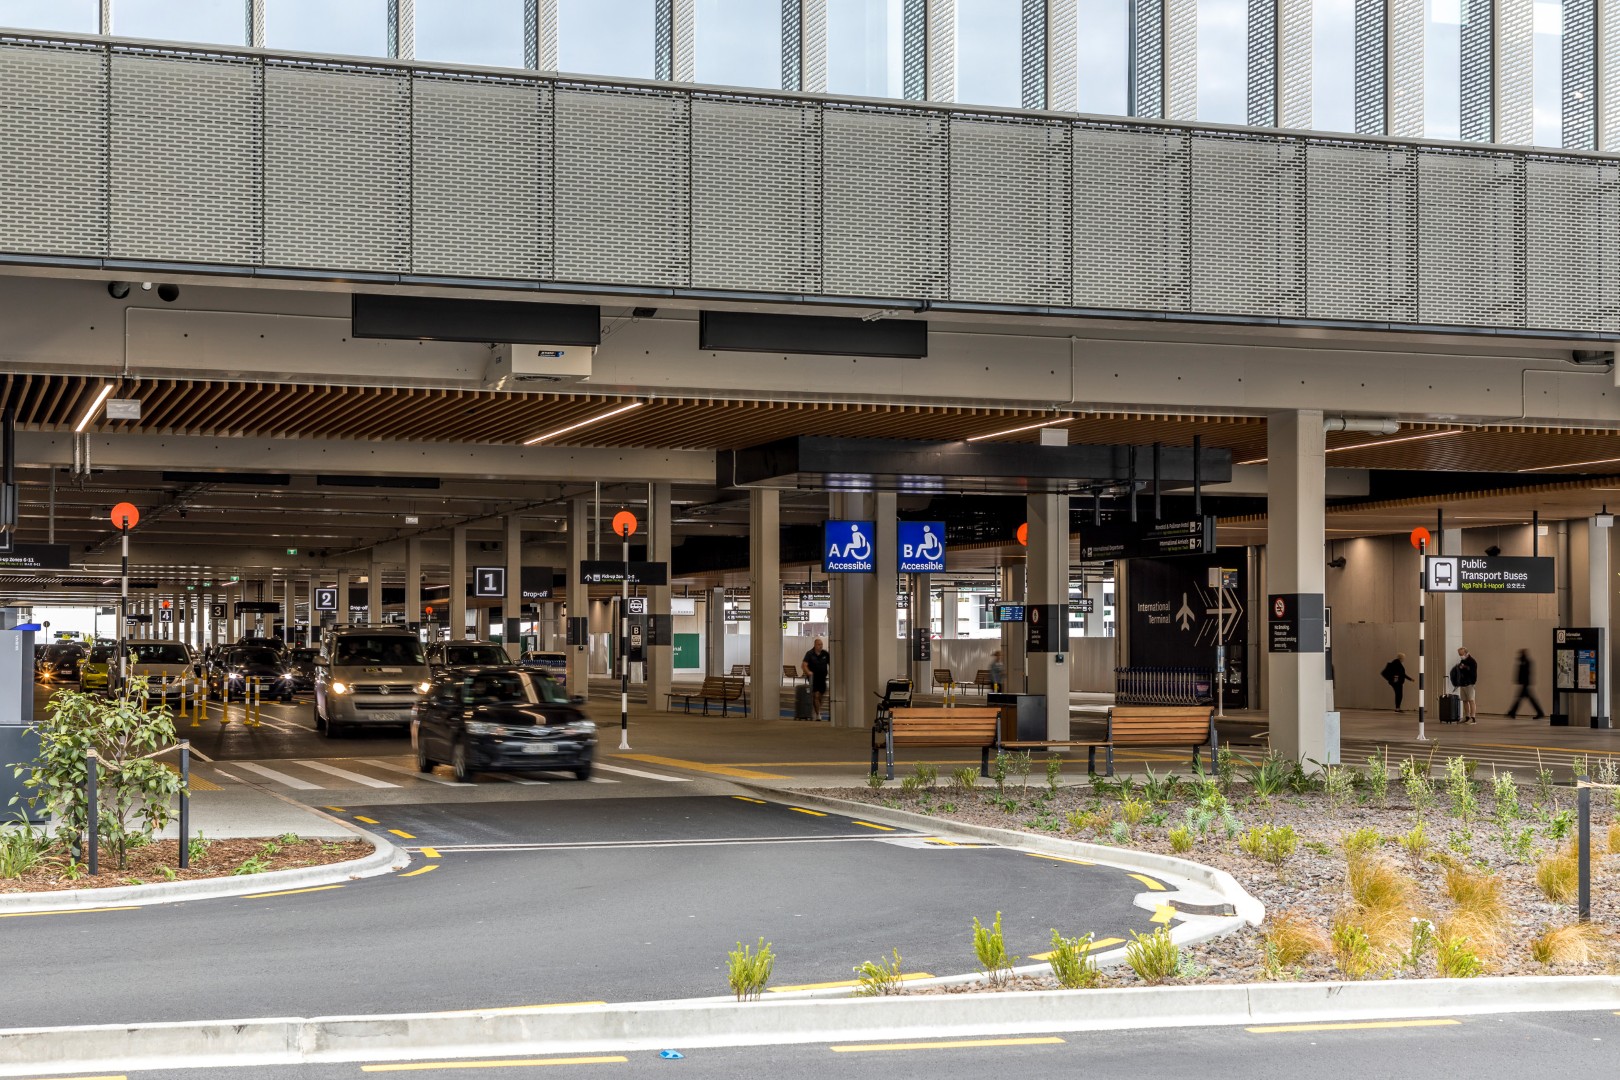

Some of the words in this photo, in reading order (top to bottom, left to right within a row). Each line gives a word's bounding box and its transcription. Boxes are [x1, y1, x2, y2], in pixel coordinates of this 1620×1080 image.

[828, 544, 840, 557] A
[903, 544, 913, 557] B
[828, 561, 871, 570] Accessible
[901, 561, 943, 570] Accessible
[1461, 559, 1487, 569] Public
[1461, 570, 1502, 582] Transport
[1503, 571, 1528, 580] Buses
[484, 574, 496, 590] 1
[322, 593, 331, 605] 2
[214, 606, 221, 616] 3
[1138, 601, 1170, 611] International
[163, 611, 170, 619] 4
[1149, 614, 1170, 624] Terminal
